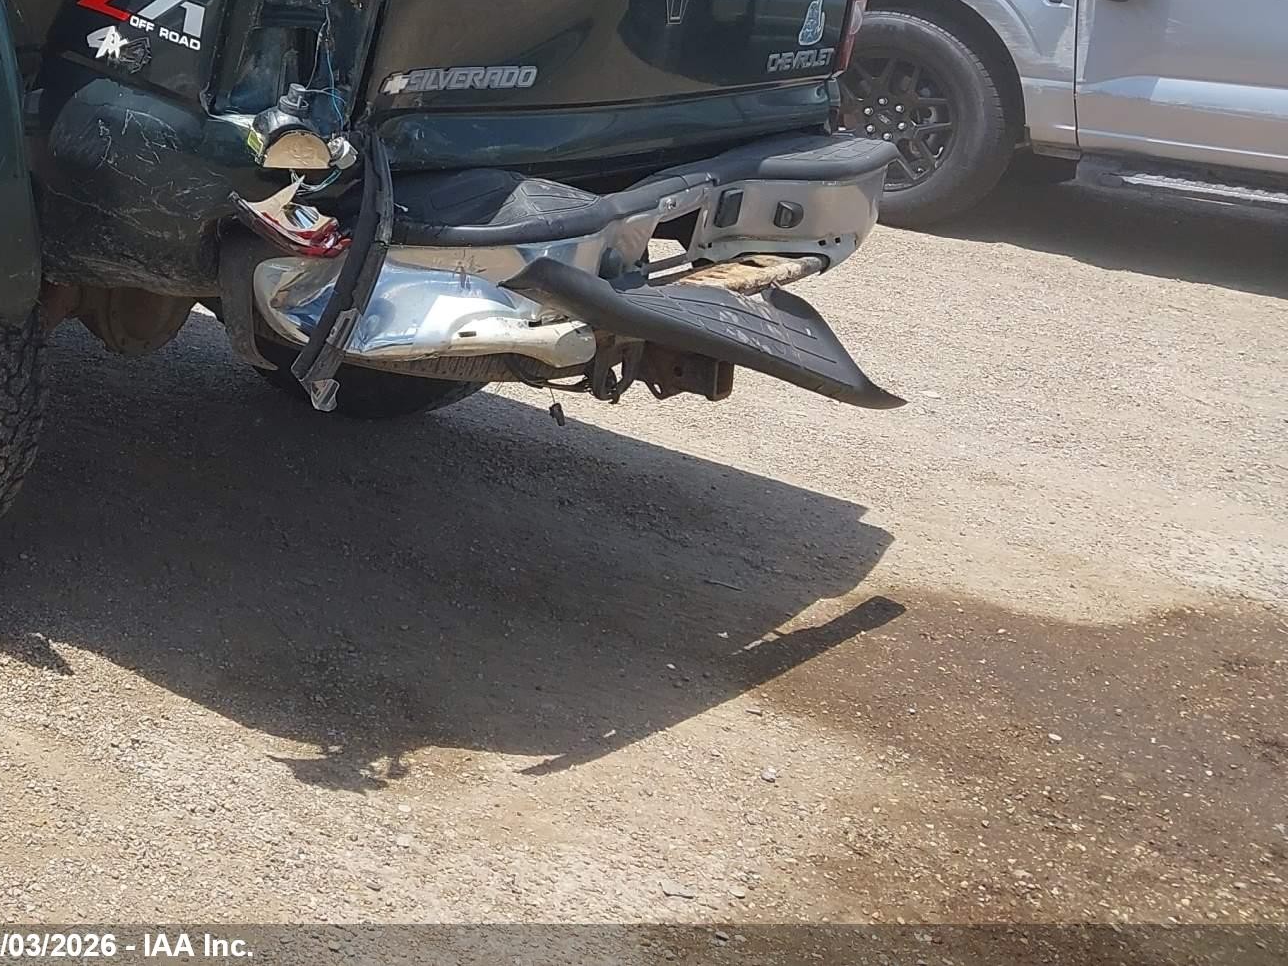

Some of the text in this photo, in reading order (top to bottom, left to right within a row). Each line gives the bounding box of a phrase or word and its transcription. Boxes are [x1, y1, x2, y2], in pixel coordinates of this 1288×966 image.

[129, 14, 202, 51] OFF ROAD
[766, 47, 835, 73] CHEVROLET
[406, 65, 538, 92] SILVERADO
